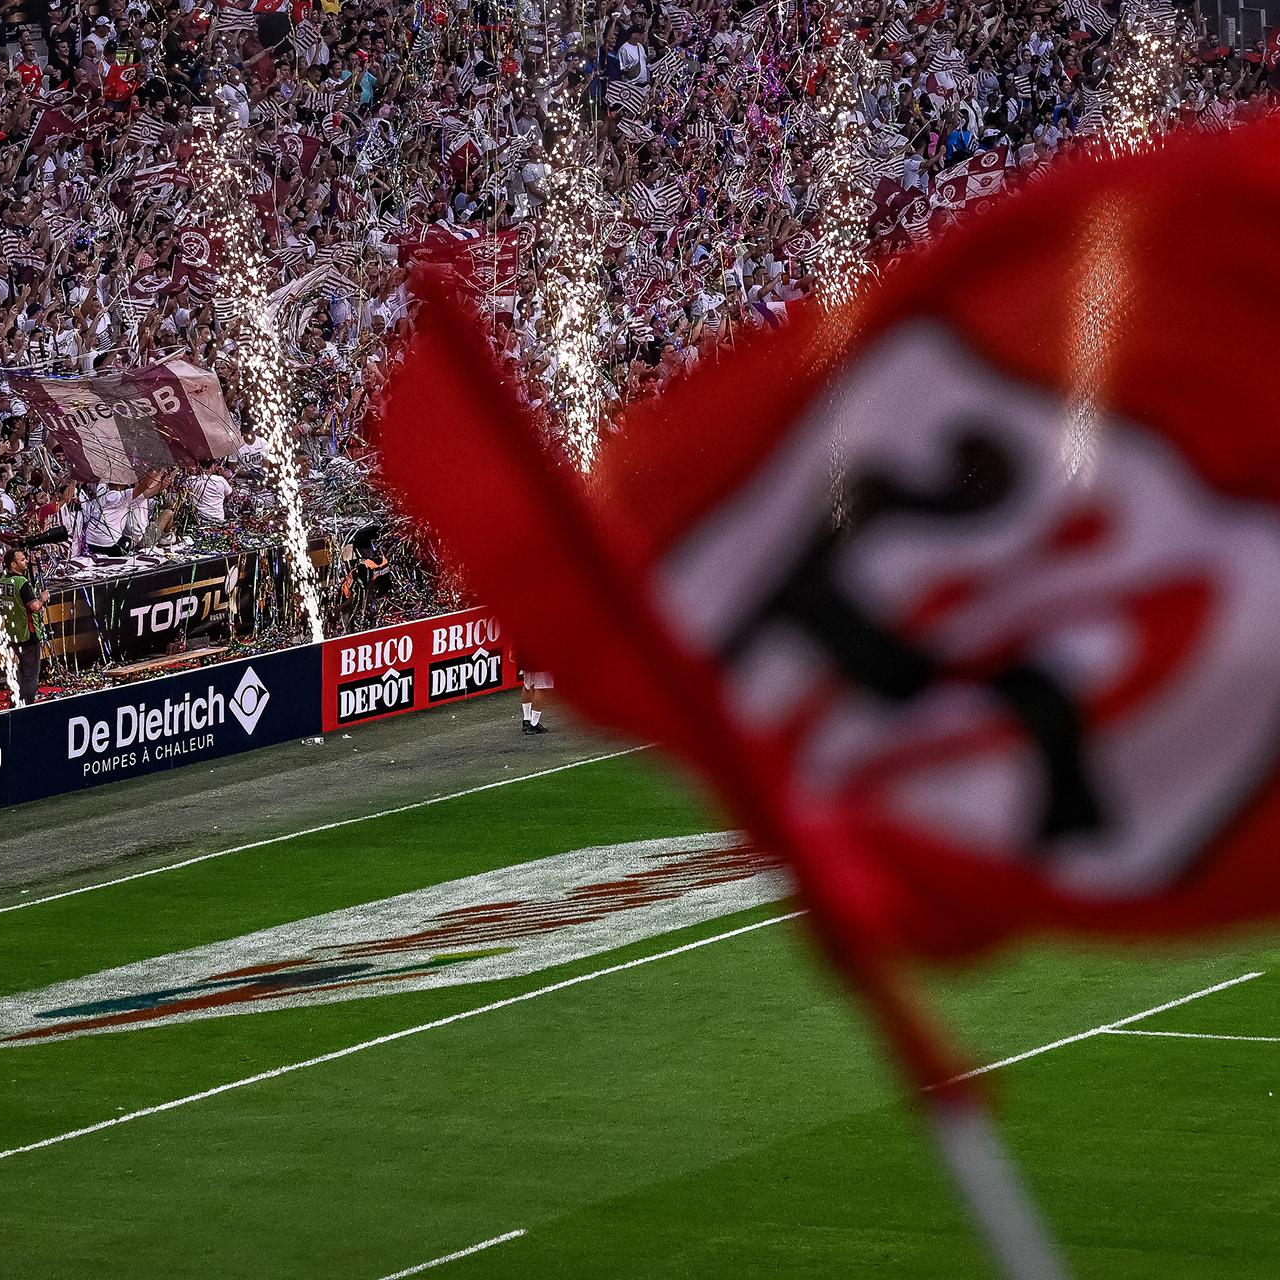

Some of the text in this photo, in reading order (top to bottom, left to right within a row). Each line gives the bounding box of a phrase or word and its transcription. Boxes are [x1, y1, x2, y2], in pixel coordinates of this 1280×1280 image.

[340, 634, 413, 677] BRICO
[432, 615, 501, 657] BRICO
[340, 667, 413, 719] DEPÔT
[431, 647, 501, 697] DEPÔT
[67, 685, 225, 760] De Dietrich
[83, 733, 214, 777] POMPES À CHALEUR
